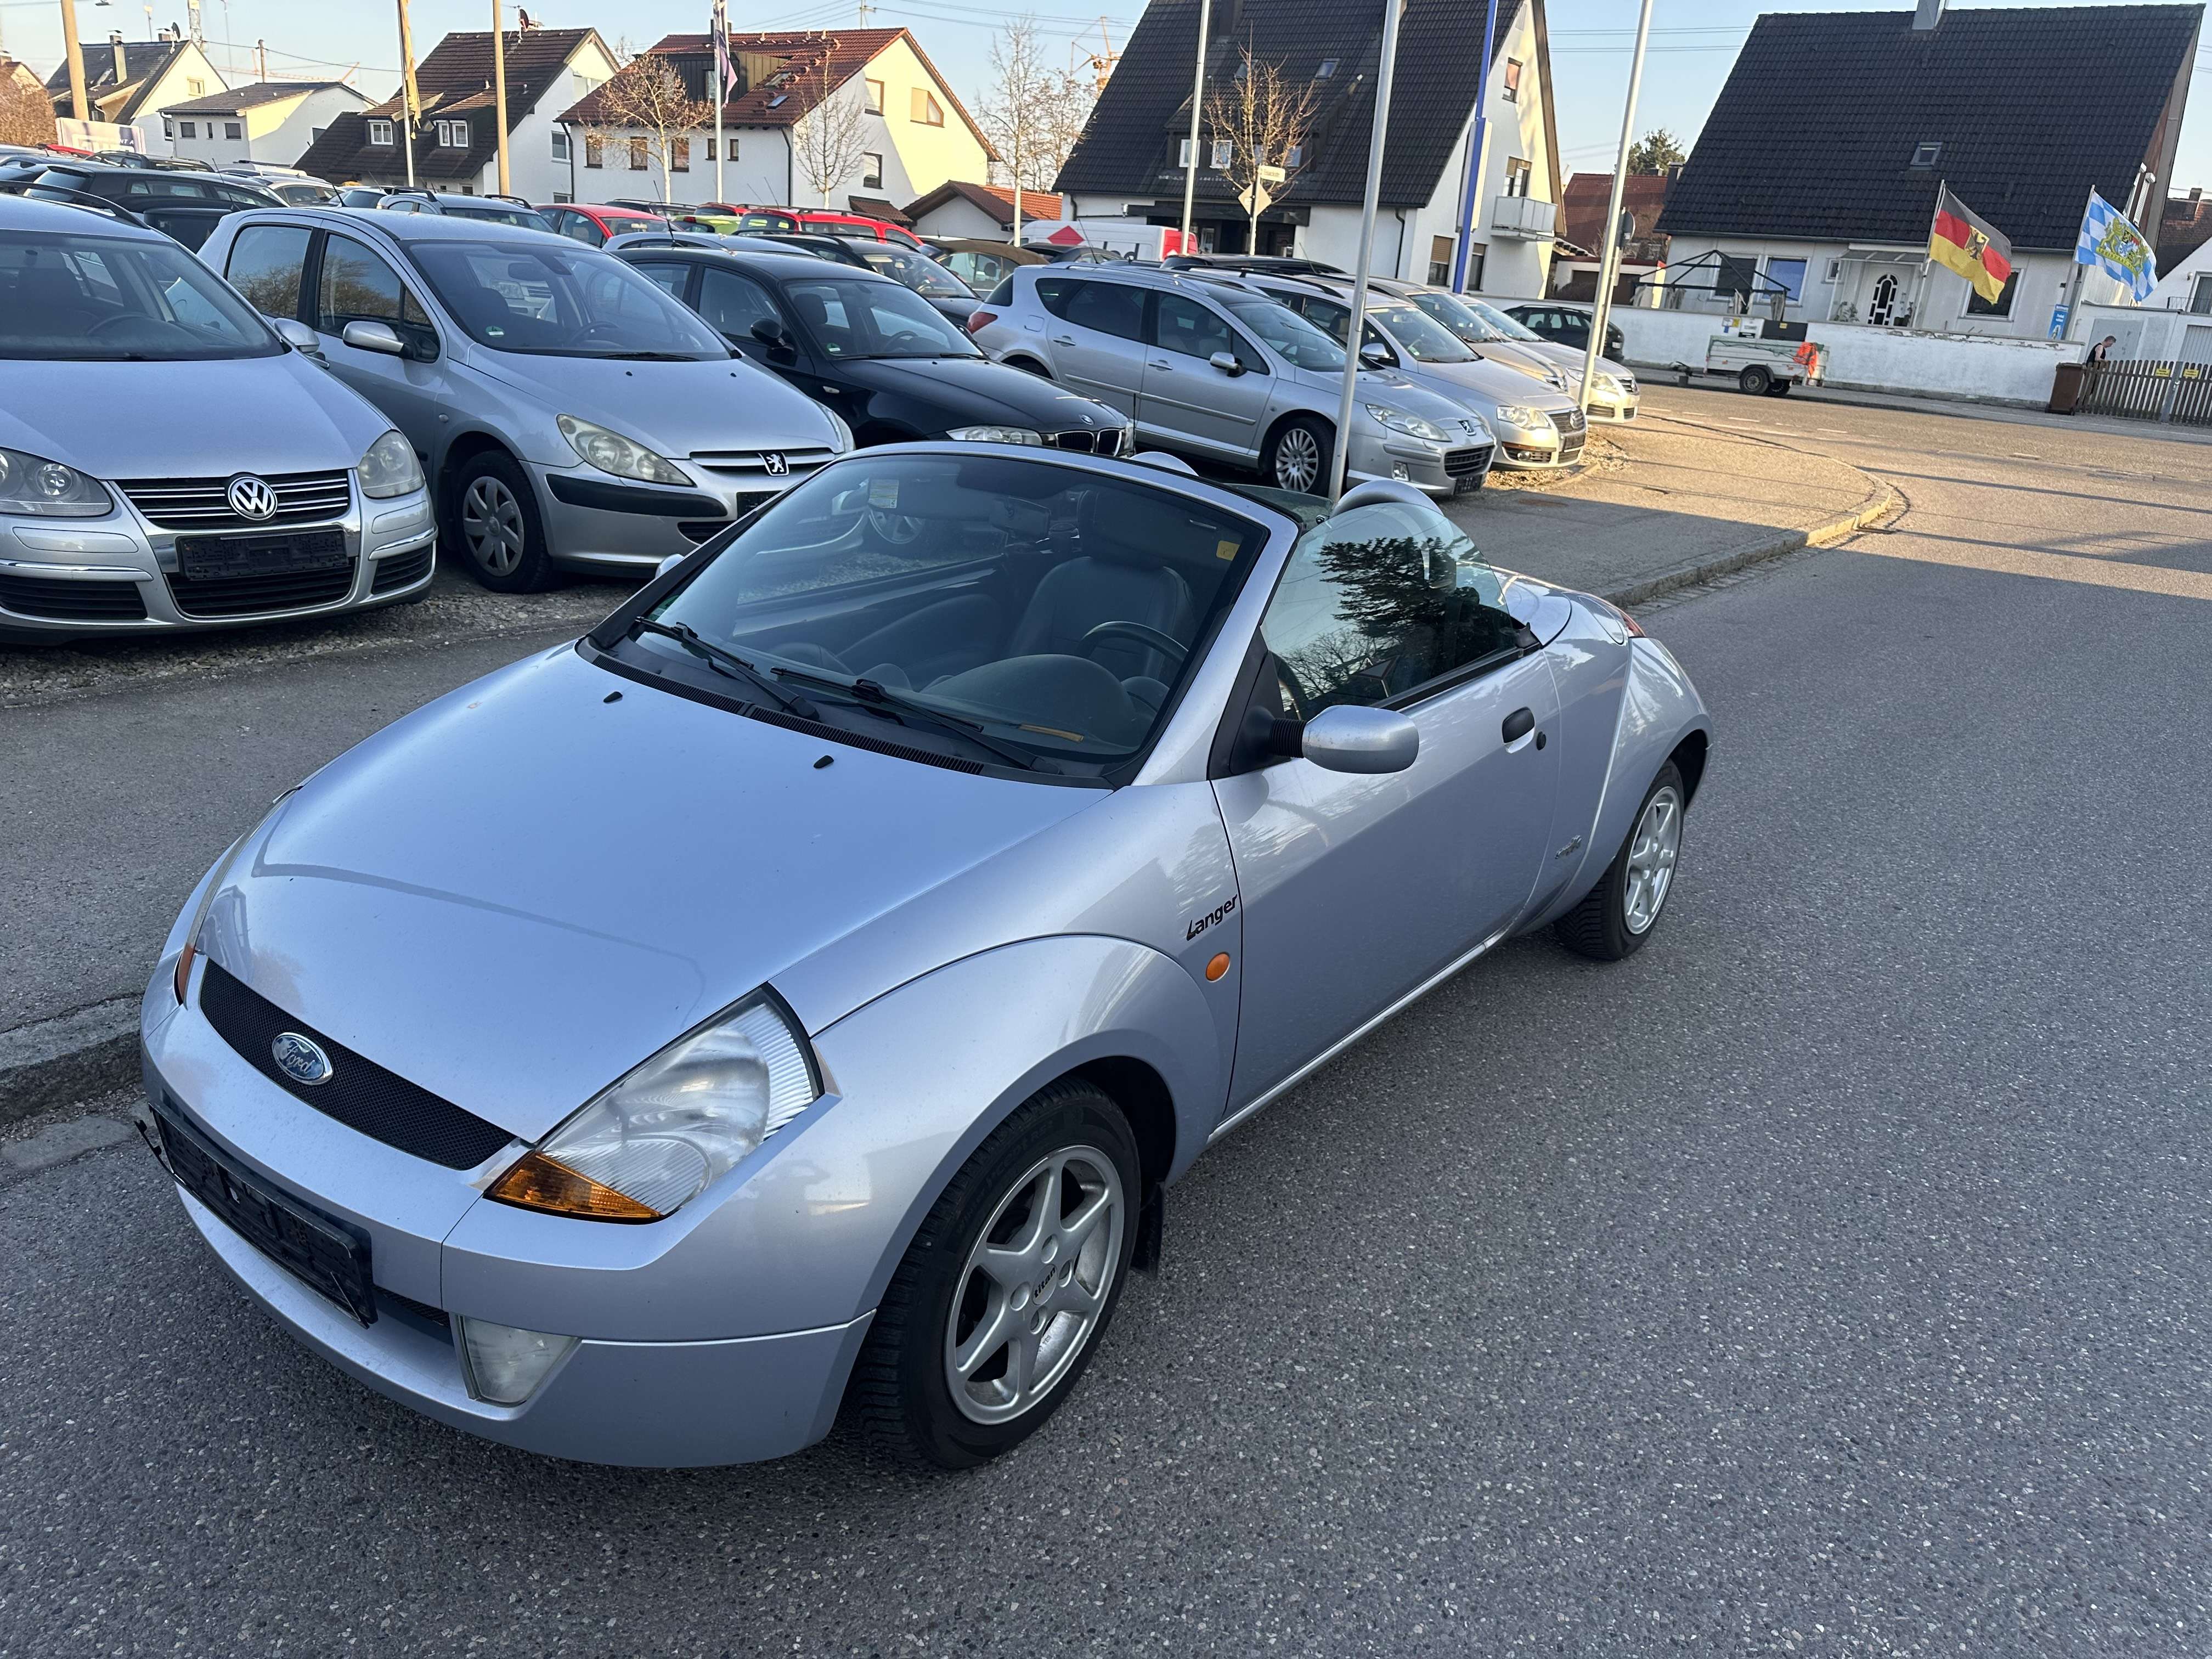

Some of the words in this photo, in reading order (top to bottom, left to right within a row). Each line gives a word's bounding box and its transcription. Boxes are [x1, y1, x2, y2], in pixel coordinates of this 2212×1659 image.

[1186, 894, 1238, 941] Langer
[279, 1040, 315, 1074] Ford
[1034, 1267, 1056, 1299] titan
